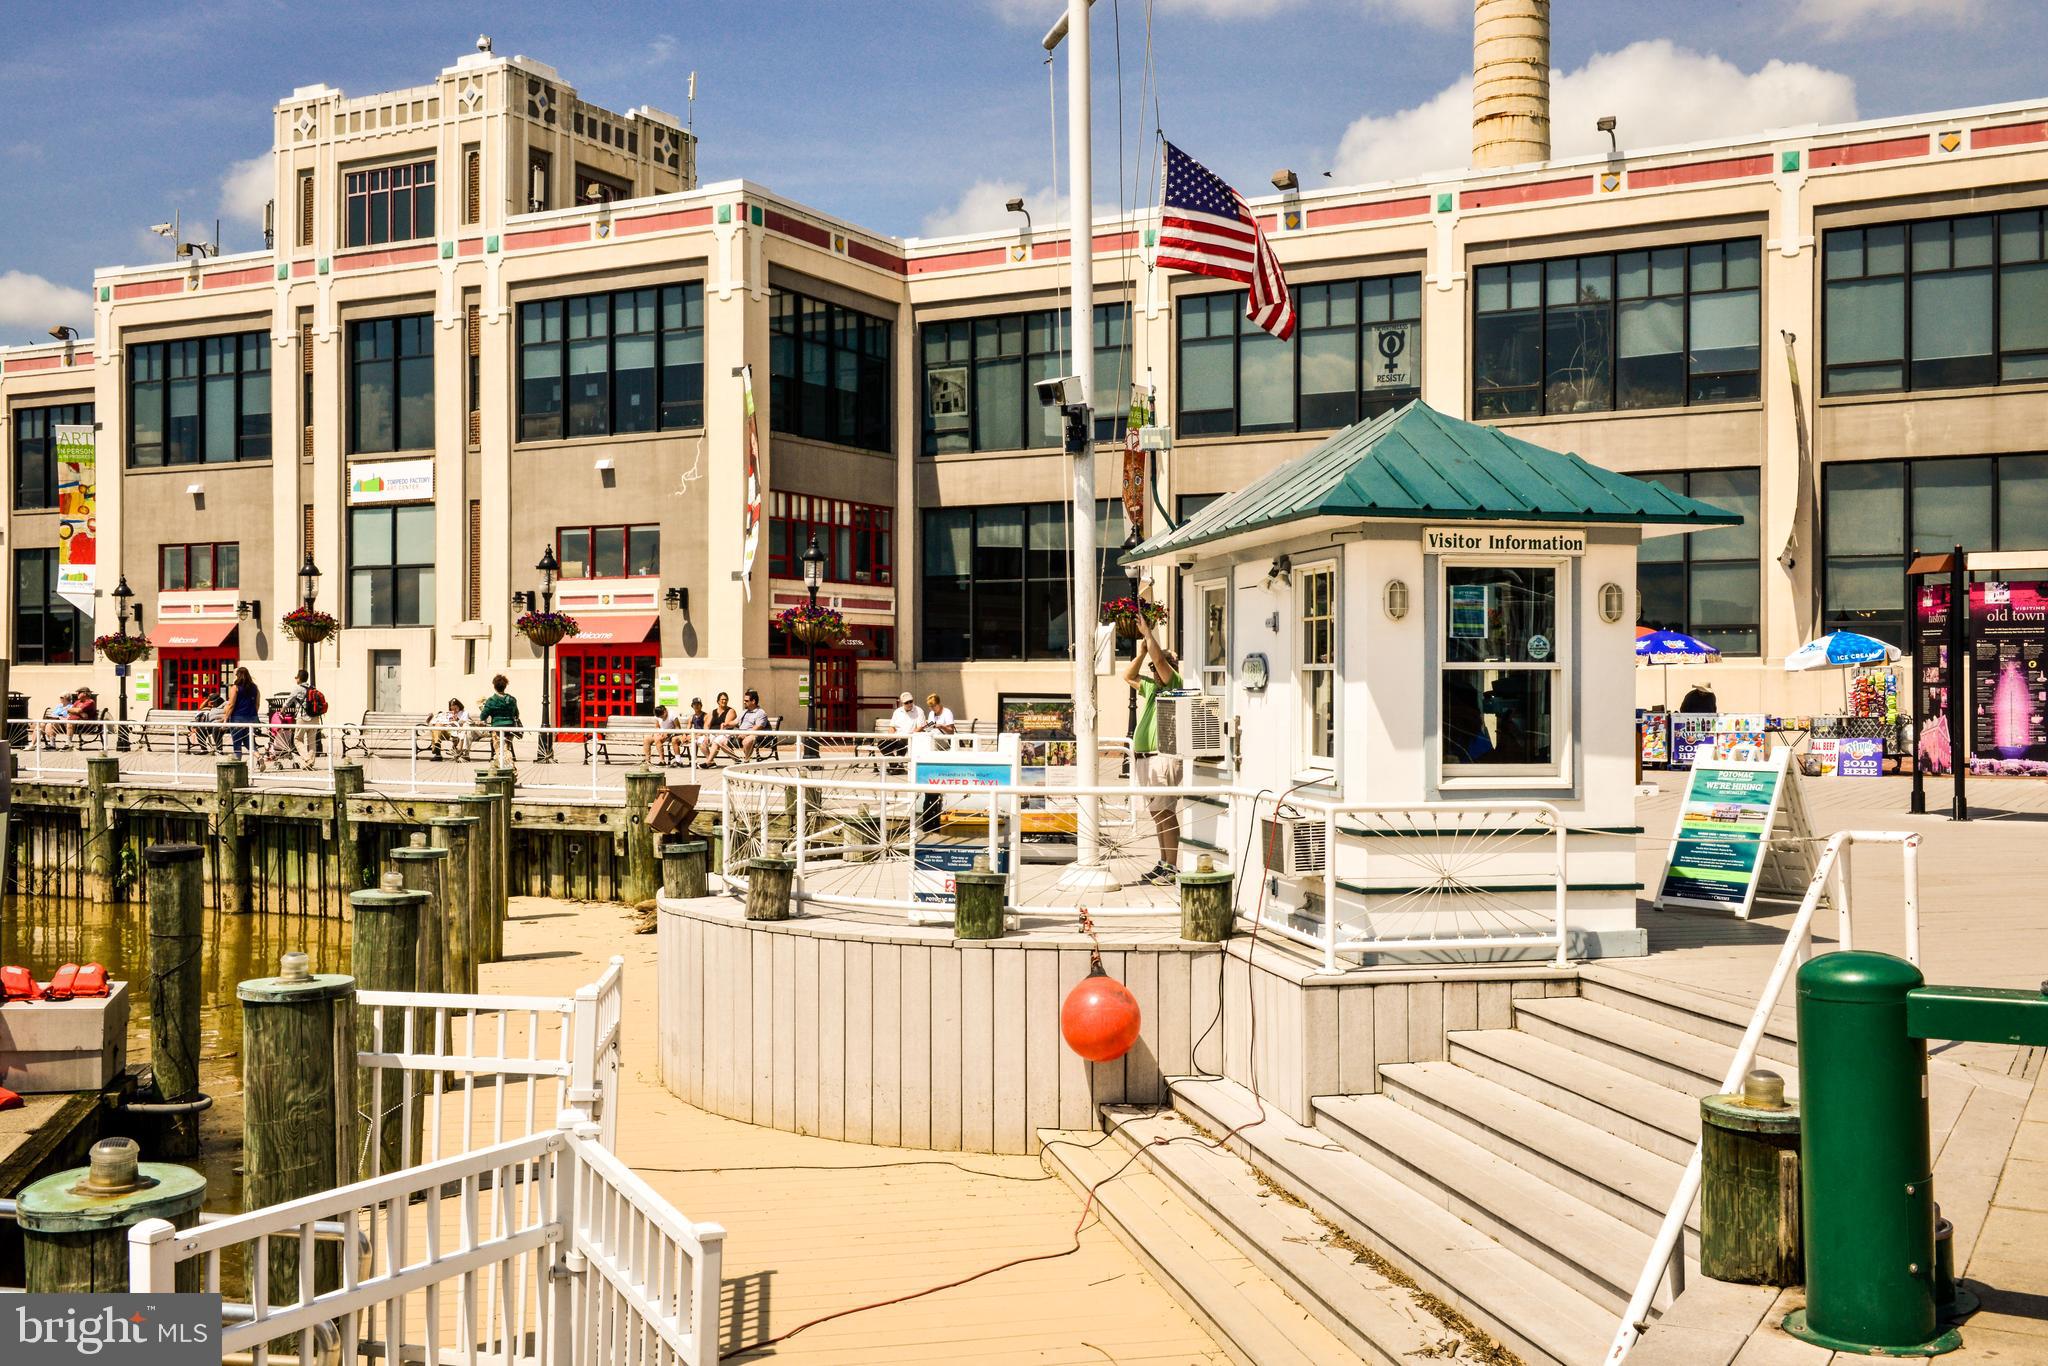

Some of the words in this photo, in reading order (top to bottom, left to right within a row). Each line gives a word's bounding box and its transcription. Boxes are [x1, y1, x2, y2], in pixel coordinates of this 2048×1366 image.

[1376, 373, 1406, 383] RESIST!
[58, 431, 94, 447] ART
[67, 448, 94, 456] PERSON
[409, 476, 431, 484] FACTORY
[1429, 533, 1482, 549] Visitor
[1489, 535, 1583, 551] Information
[1928, 611, 1947, 626] history
[1987, 609, 2008, 621] old
[2012, 610, 2045, 621] town
[1811, 742, 1821, 751] ALL
[1823, 742, 1835, 751] BEEF
[1844, 760, 1878, 768] SOLD
[1844, 768, 1878, 776] HERE
[1706, 782, 1731, 790] WE'RE
[1731, 783, 1764, 791] HIRING!
